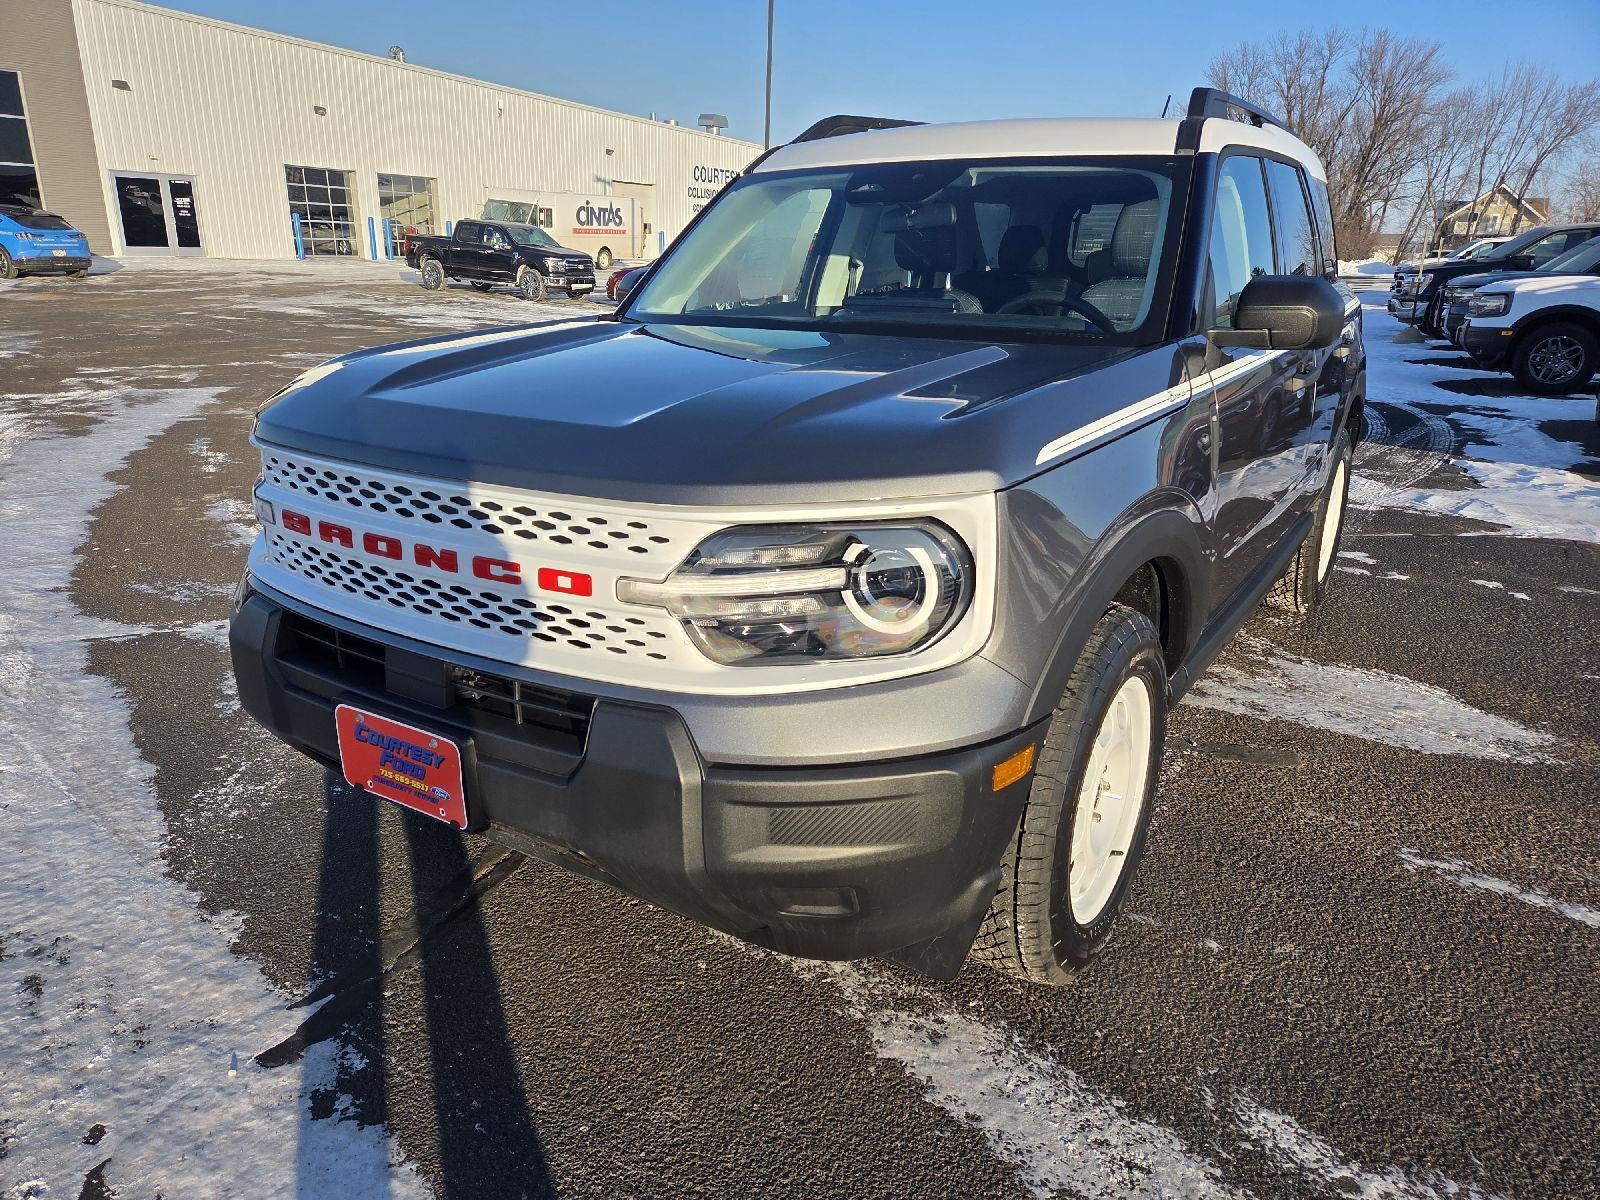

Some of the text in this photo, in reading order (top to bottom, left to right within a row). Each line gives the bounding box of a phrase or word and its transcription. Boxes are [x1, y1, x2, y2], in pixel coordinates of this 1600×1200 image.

[693, 165, 739, 184] COURTES
[575, 199, 623, 227] CINTAS
[281, 508, 593, 597] BRONCO
[354, 723, 445, 769] COURTESY
[379, 751, 426, 781] FORD
